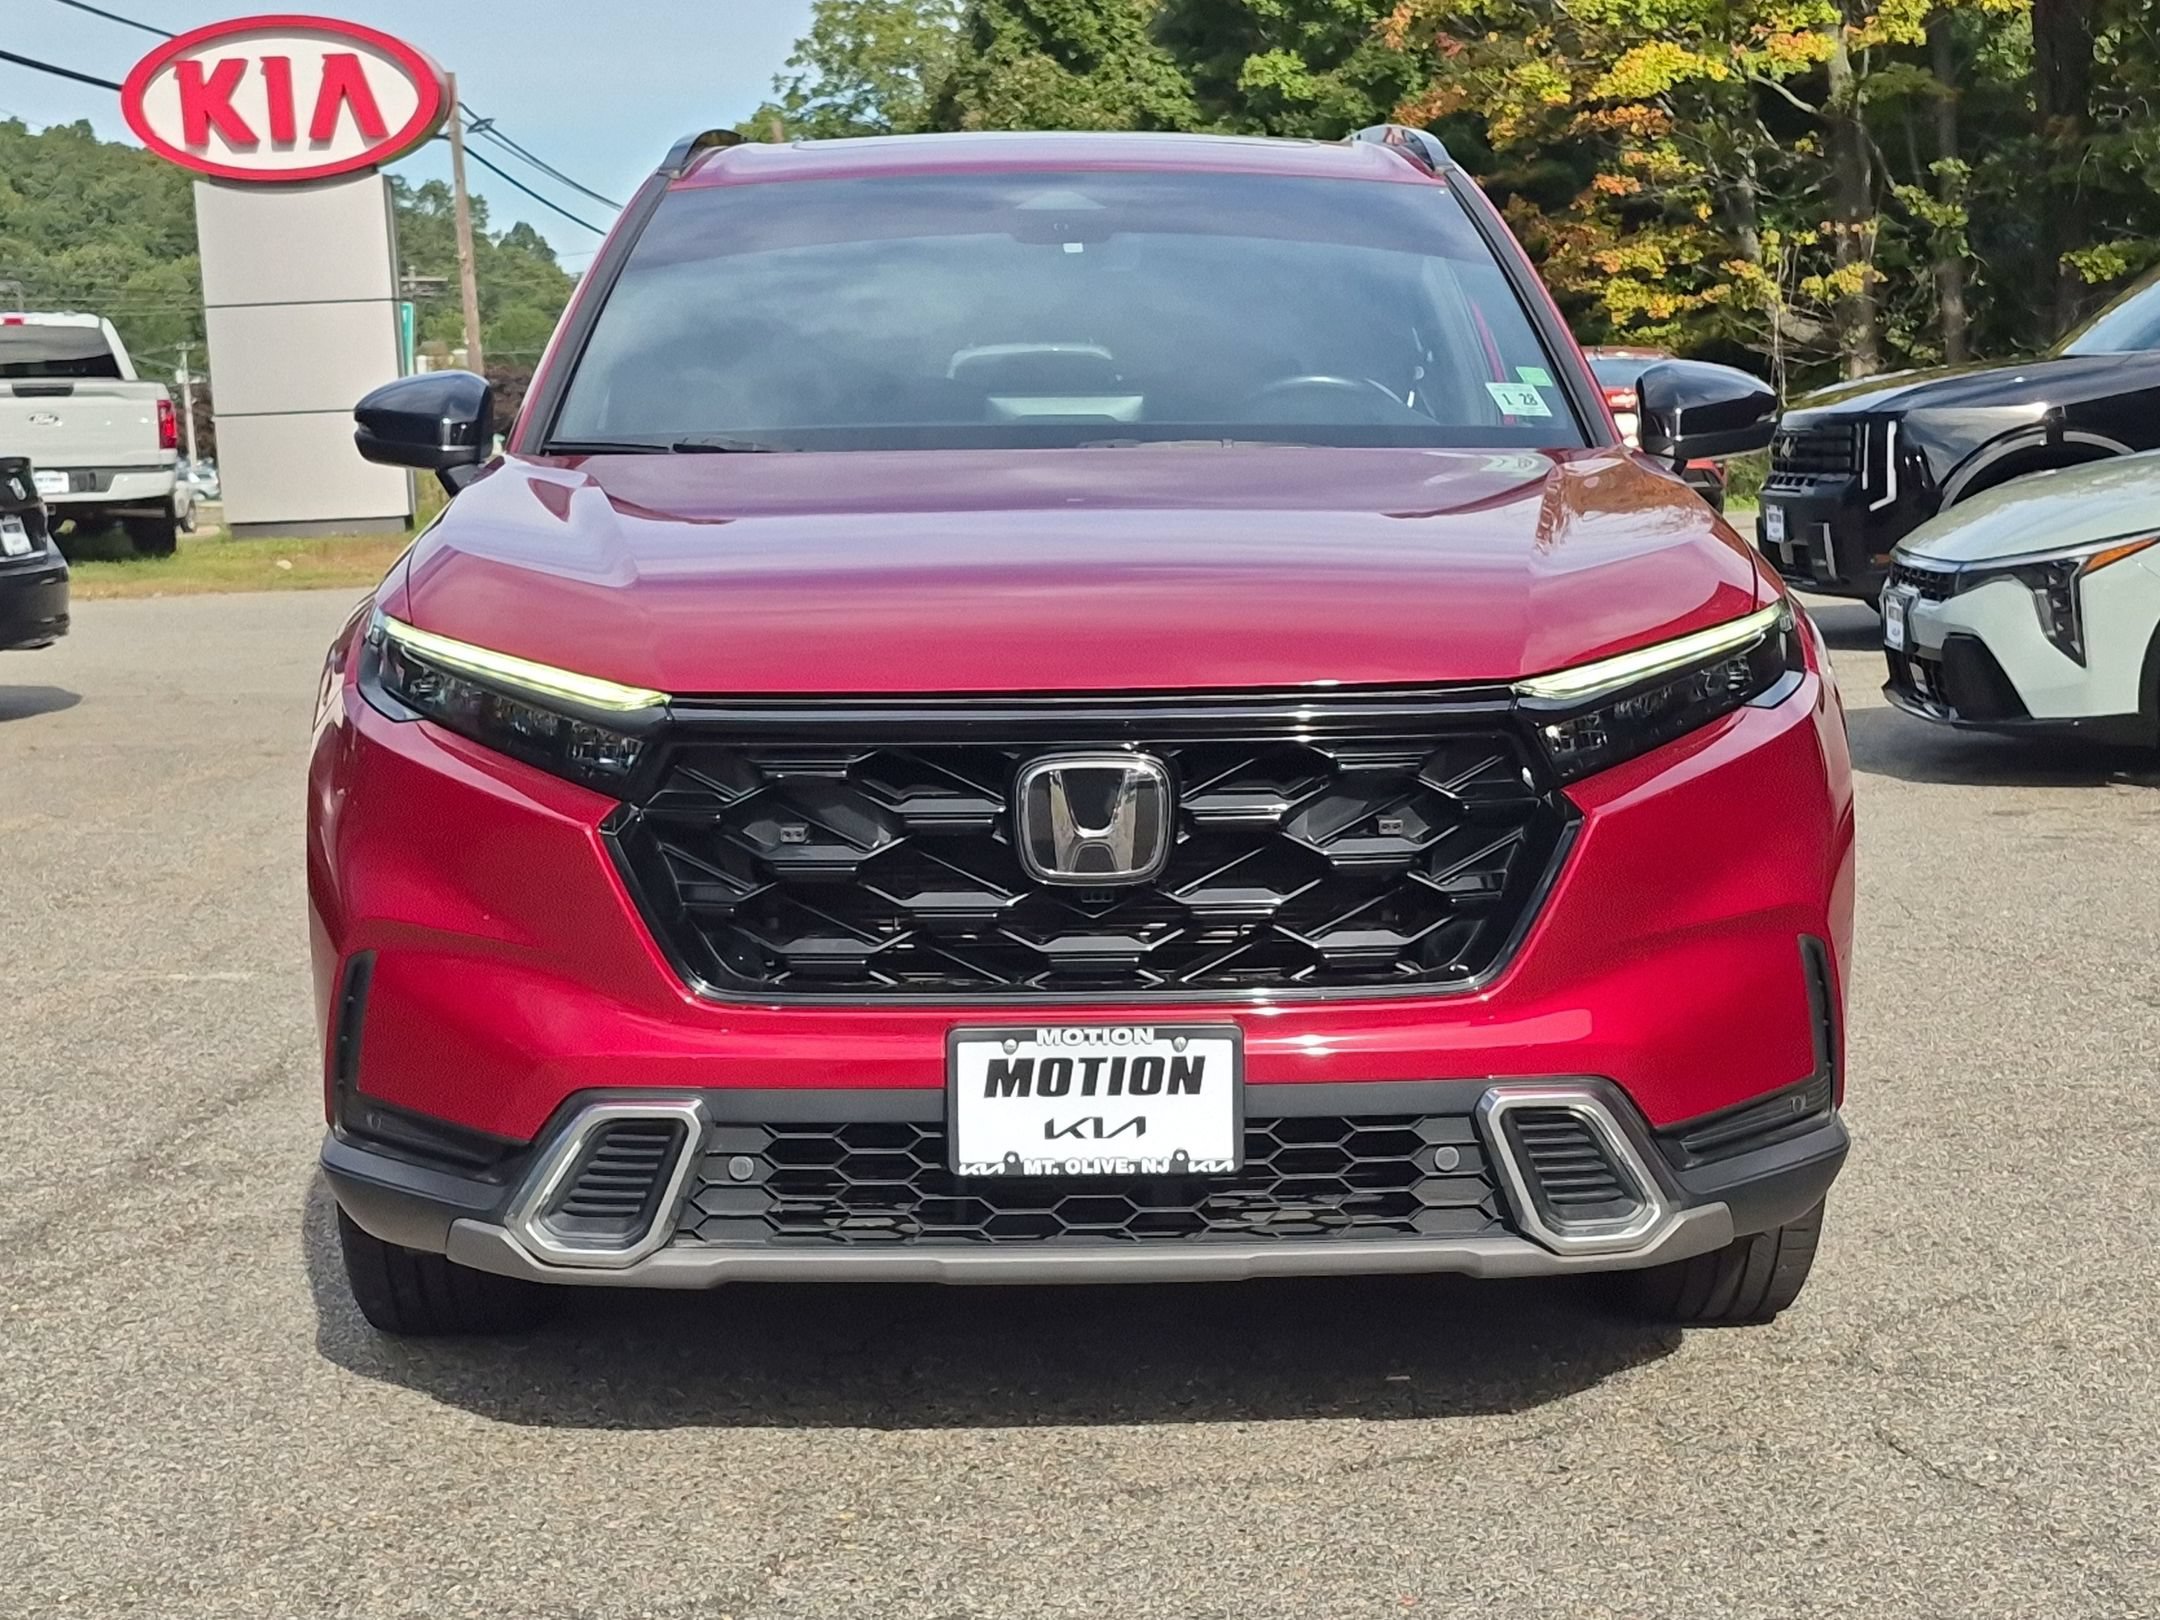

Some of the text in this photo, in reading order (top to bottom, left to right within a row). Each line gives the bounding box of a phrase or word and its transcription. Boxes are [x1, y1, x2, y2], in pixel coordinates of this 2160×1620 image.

[173, 53, 389, 146] KIA
[1036, 1027, 1155, 1046] MOTION
[984, 1055, 1206, 1098] MOTION
[1023, 1158, 1170, 1175] MT. OLIVE, NJ
